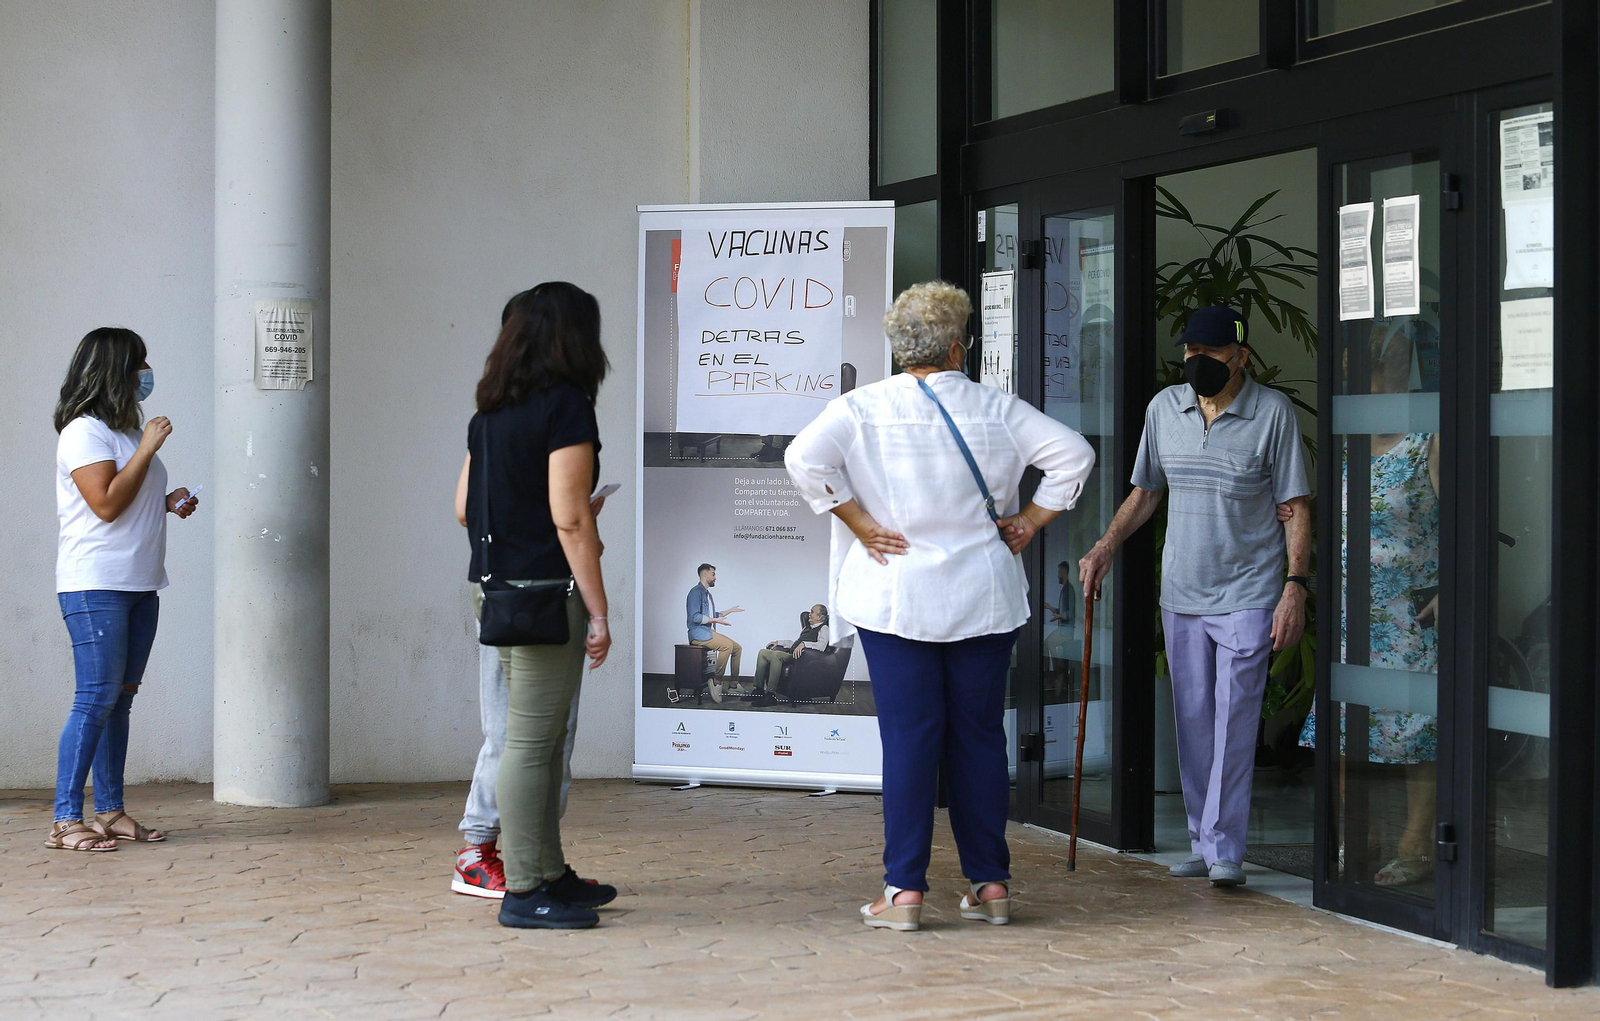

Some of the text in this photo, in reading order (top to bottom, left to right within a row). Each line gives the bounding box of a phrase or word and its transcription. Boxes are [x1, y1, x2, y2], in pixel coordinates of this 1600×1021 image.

[708, 230, 830, 259] VACUNAS
[704, 276, 834, 311] COVID
[701, 329, 806, 345] DETRAS
[264, 346, 306, 354] 669-946-205
[698, 353, 769, 366] EN EL
[708, 371, 835, 392] PARKING
[734, 478, 750, 486] Deja
[766, 478, 782, 486] lado
[783, 478, 790, 486] la
[734, 488, 767, 497] Comparte
[734, 508, 791, 517] COMPARTE VIDA.
[734, 533, 805, 541] info@fundacionharena.org
